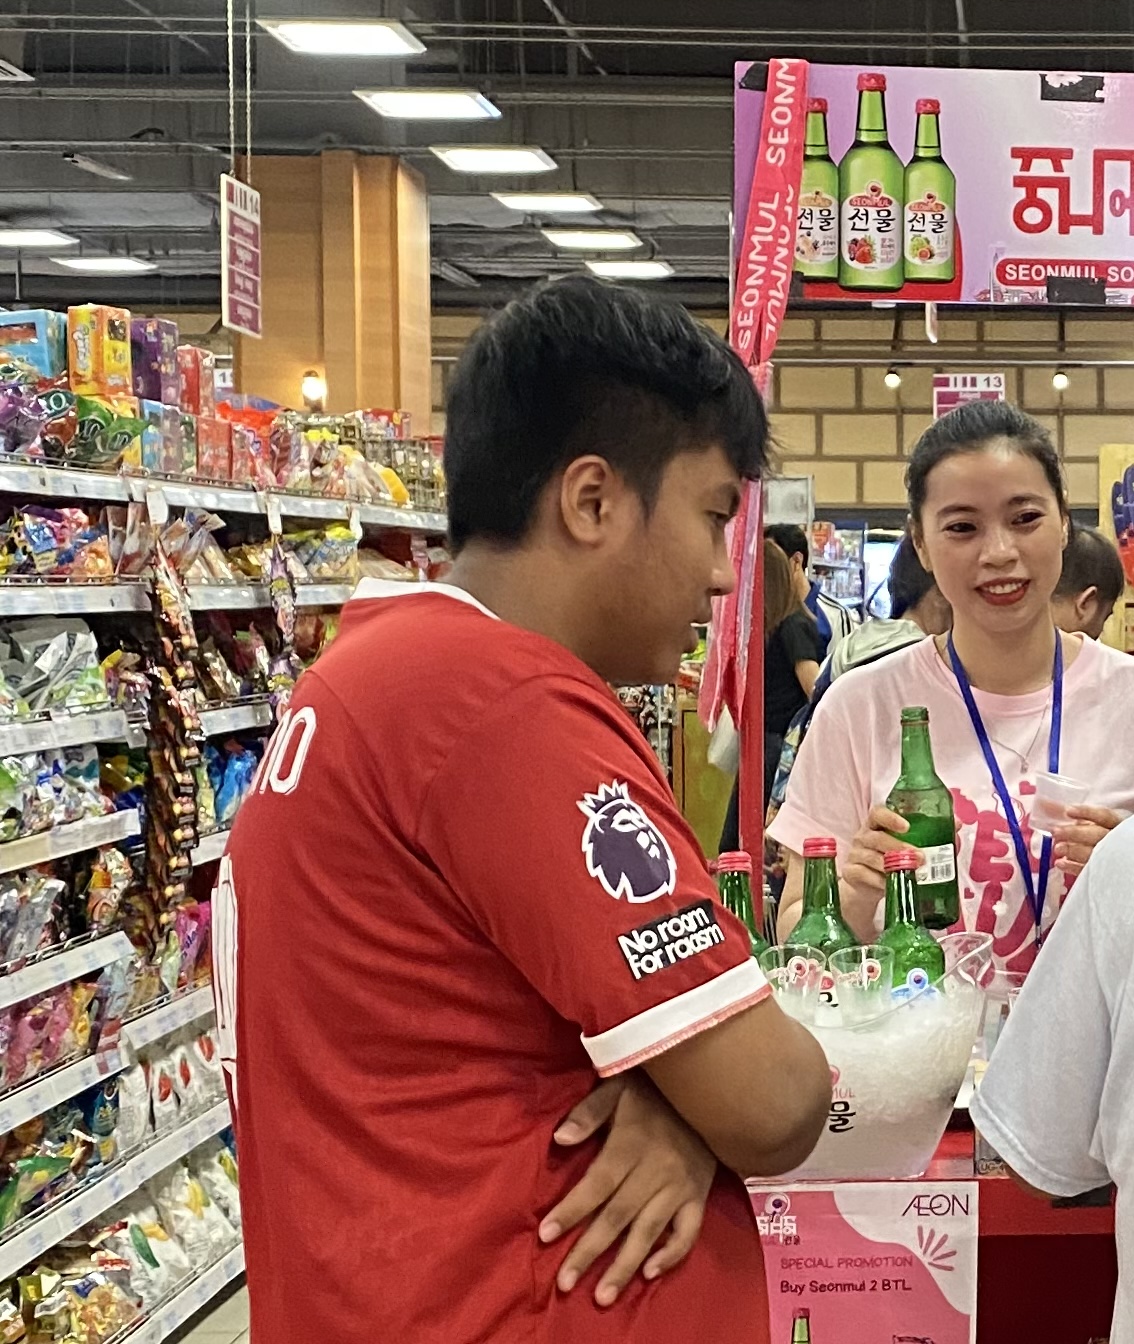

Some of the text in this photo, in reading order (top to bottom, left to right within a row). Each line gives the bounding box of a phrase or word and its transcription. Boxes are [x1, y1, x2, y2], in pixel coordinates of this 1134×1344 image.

[848, 208, 896, 233] 선물
[907, 213, 948, 233] 선물
[737, 192, 780, 349] SEONMUL
[983, 376, 1003, 388] 13
[618, 907, 710, 958] No room
[781, 1256, 913, 1269] SPECIAL PROMOTION
[780, 1279, 912, 1296] Buy Seonmul 2 BTL
